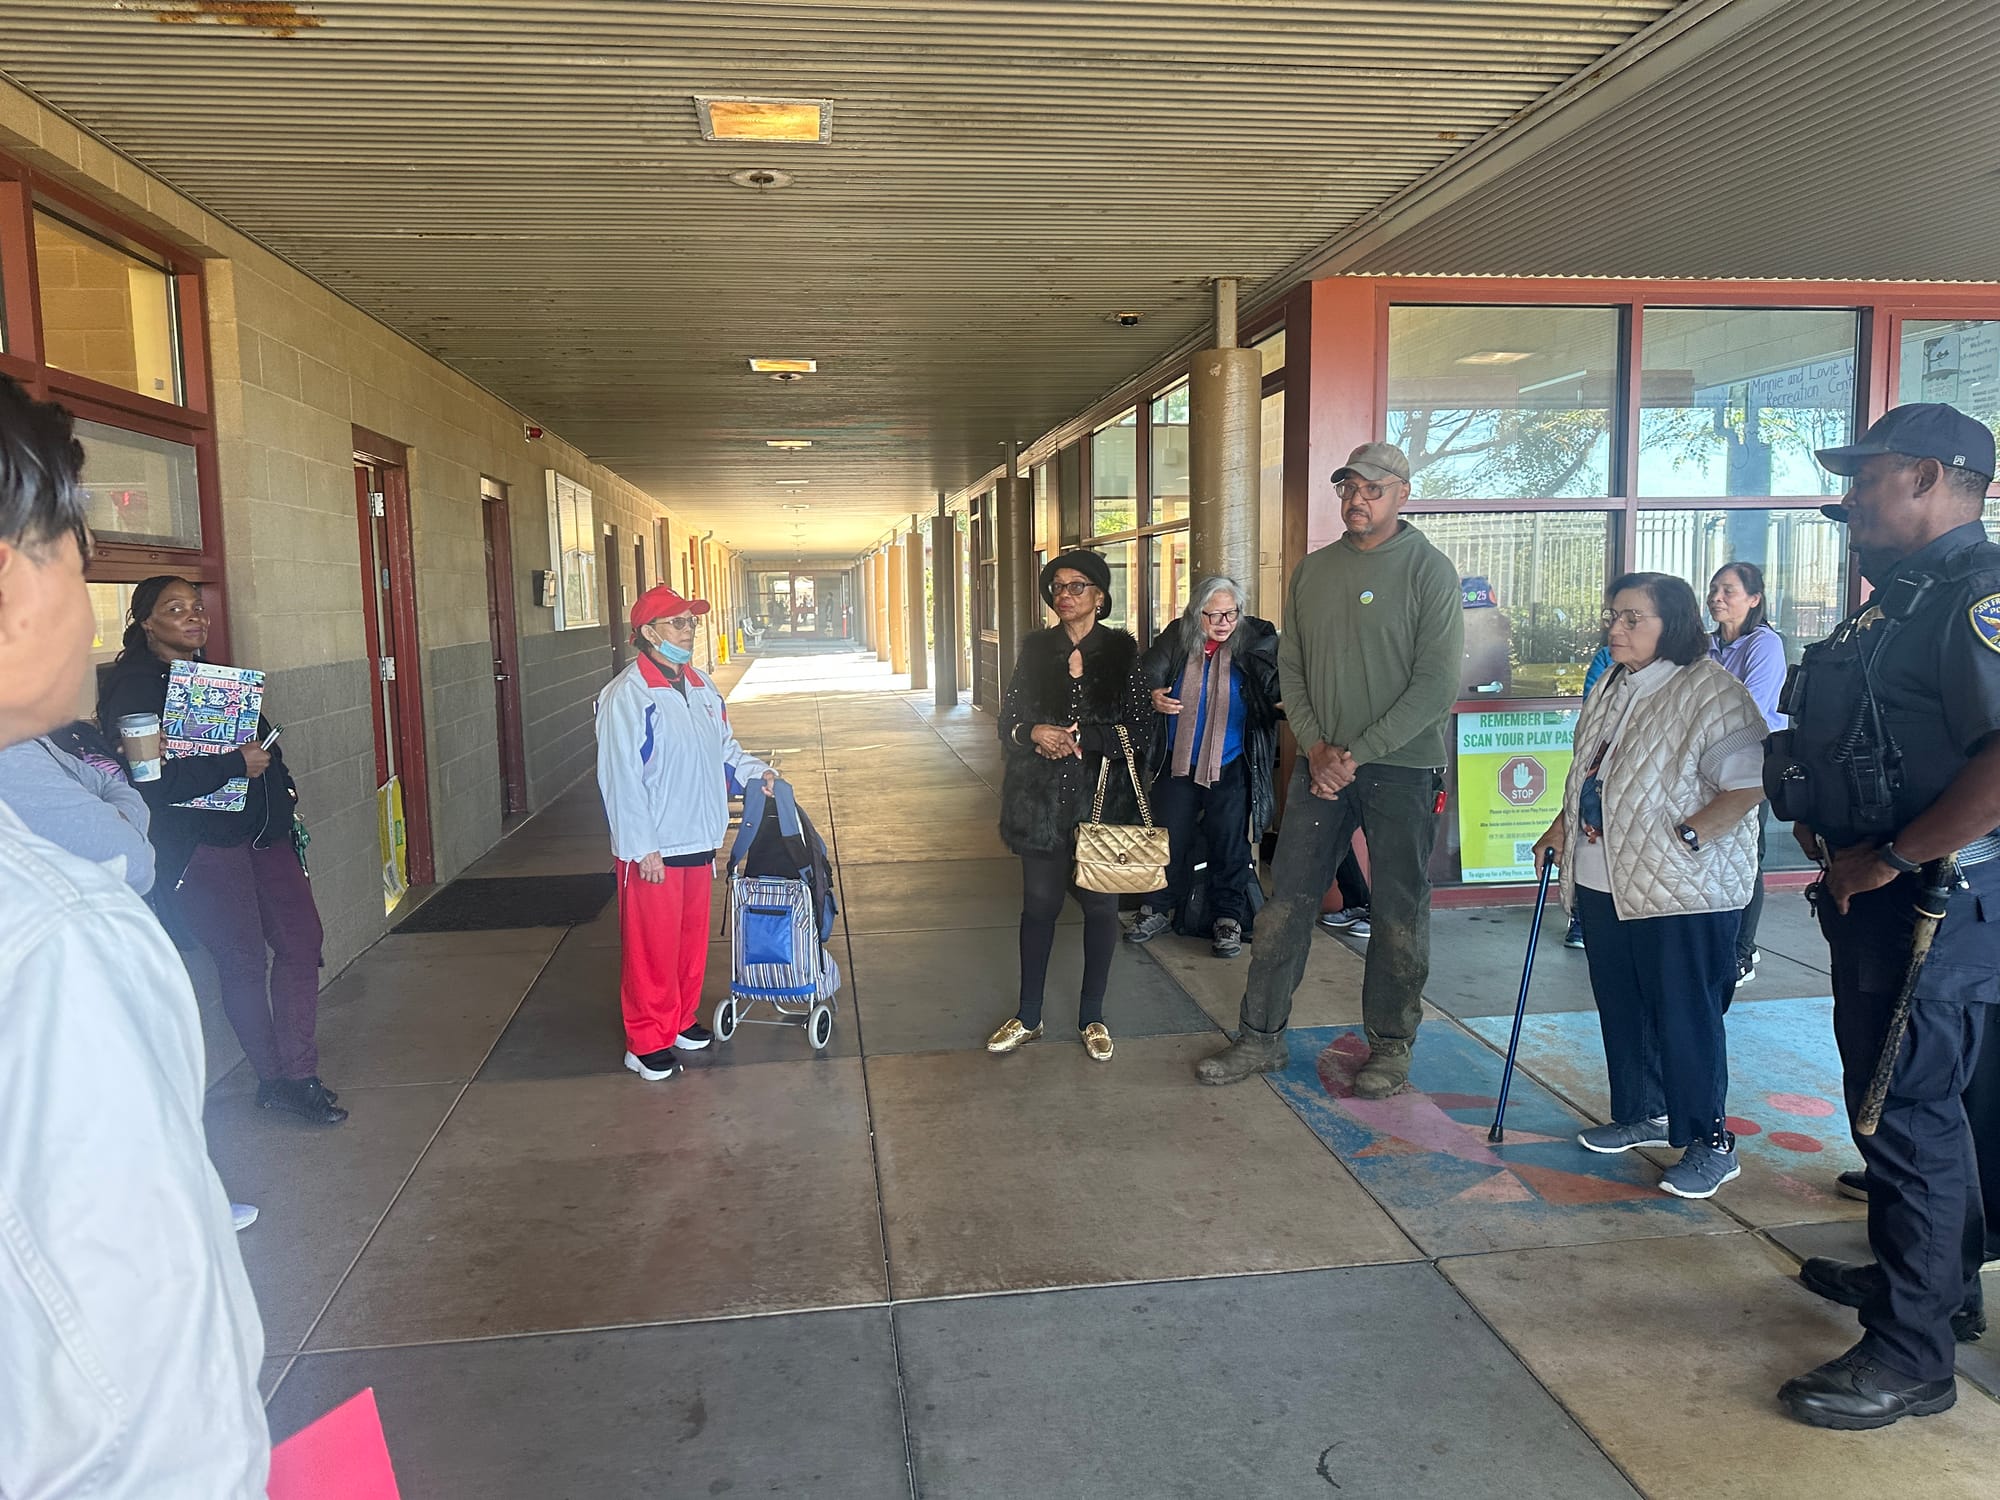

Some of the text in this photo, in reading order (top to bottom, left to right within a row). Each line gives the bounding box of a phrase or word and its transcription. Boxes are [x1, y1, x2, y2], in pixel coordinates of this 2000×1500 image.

[1751, 377, 1784, 395] Minnie
[1788, 368, 1803, 386] and
[1809, 363, 1840, 380] Lovie
[1766, 382, 1819, 408] Recreation
[1974, 601, 1991, 614] SAN
[1480, 712, 1541, 728] REMEMBER
[1463, 733, 1492, 747] SCAN
[1495, 732, 1524, 746] YOUR
[1527, 731, 1552, 745] PLAY
[1511, 789, 1534, 800] STOP
